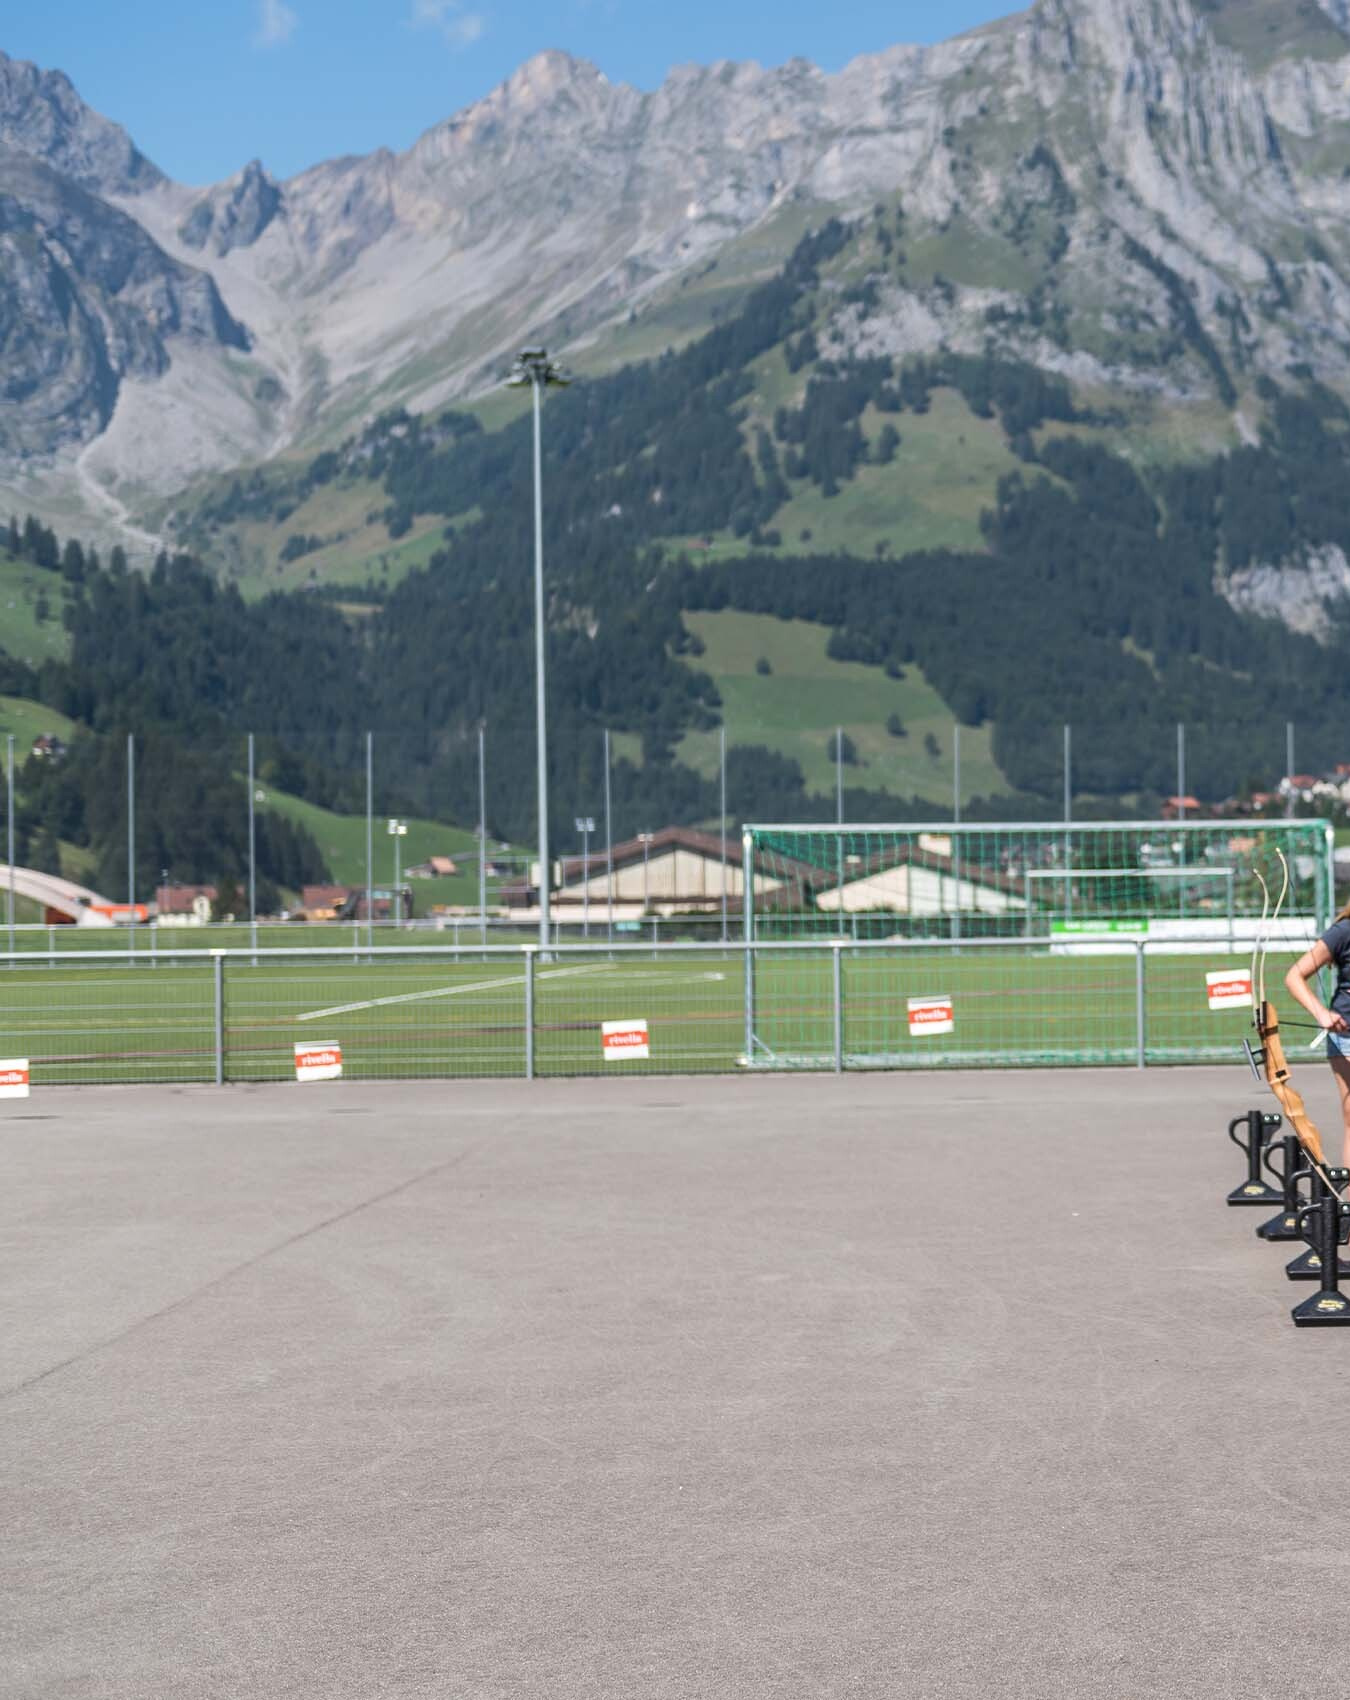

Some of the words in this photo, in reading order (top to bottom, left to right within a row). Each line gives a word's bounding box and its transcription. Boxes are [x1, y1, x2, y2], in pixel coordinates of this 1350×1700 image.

[1212, 982, 1246, 997] rivella
[914, 1009, 948, 1024] rivella
[608, 1032, 643, 1047] rivella
[301, 1052, 336, 1067] rivella
